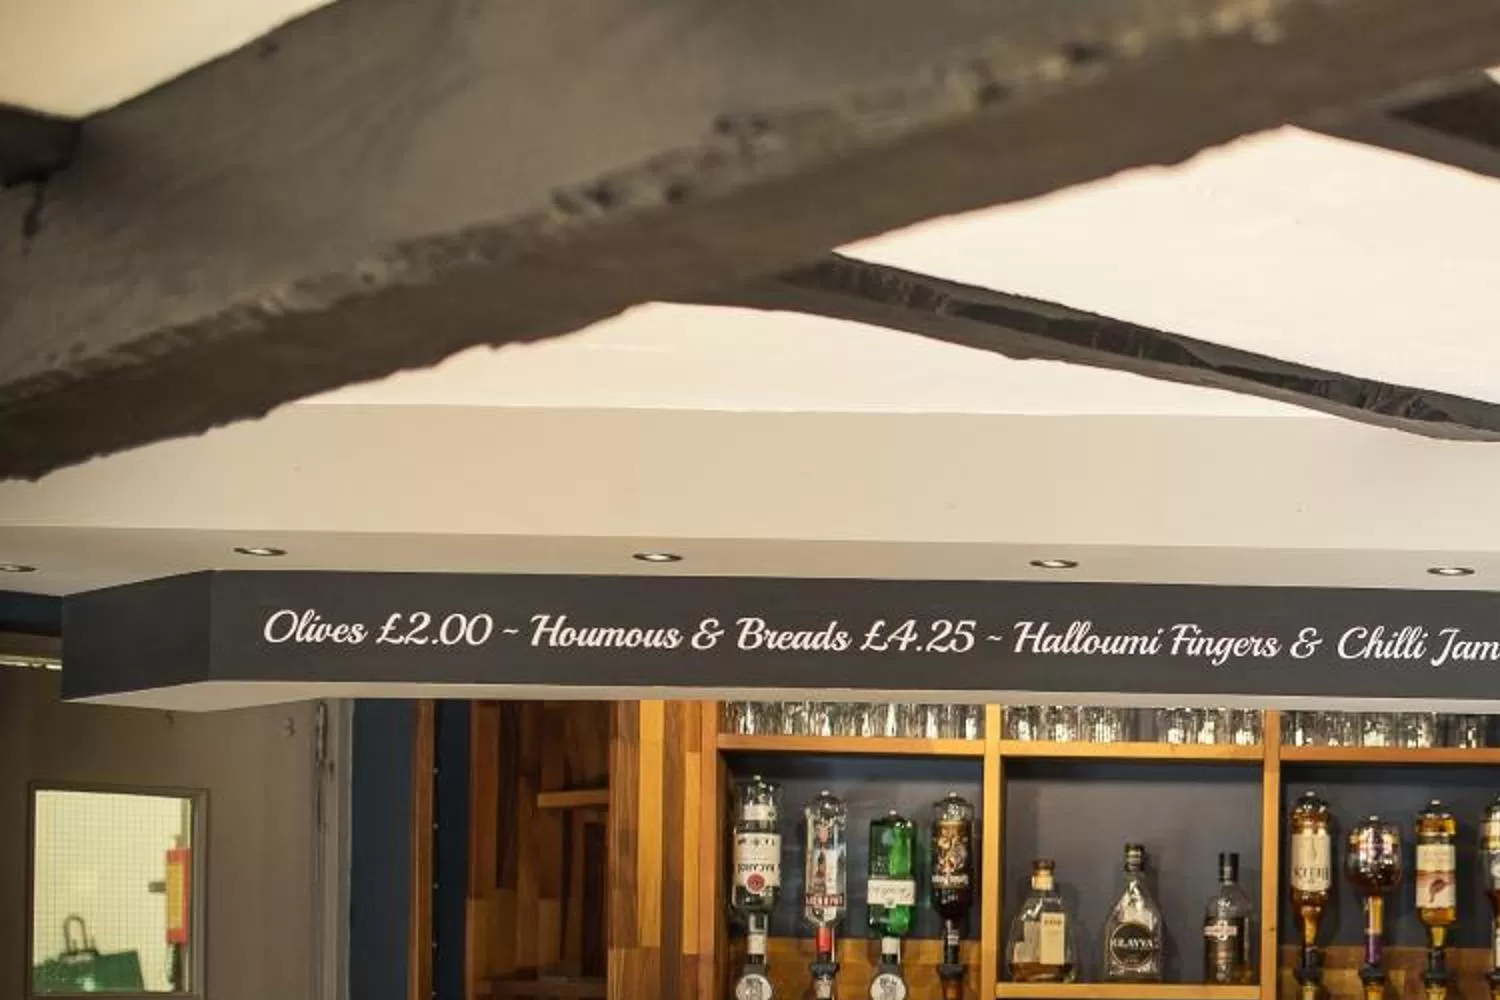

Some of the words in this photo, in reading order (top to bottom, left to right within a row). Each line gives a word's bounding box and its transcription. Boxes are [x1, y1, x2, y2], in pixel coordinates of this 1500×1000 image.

[263, 608, 369, 645] Olives
[375, 611, 494, 646] £2.00
[530, 613, 684, 649] Houmous
[690, 617, 725, 650] &
[735, 617, 853, 652] Breads
[859, 619, 977, 653] £4.25
[1013, 620, 1165, 656] Halloumi
[1170, 623, 1283, 667] Fingers
[1289, 626, 1324, 659] &
[1337, 625, 1427, 661] Chilli
